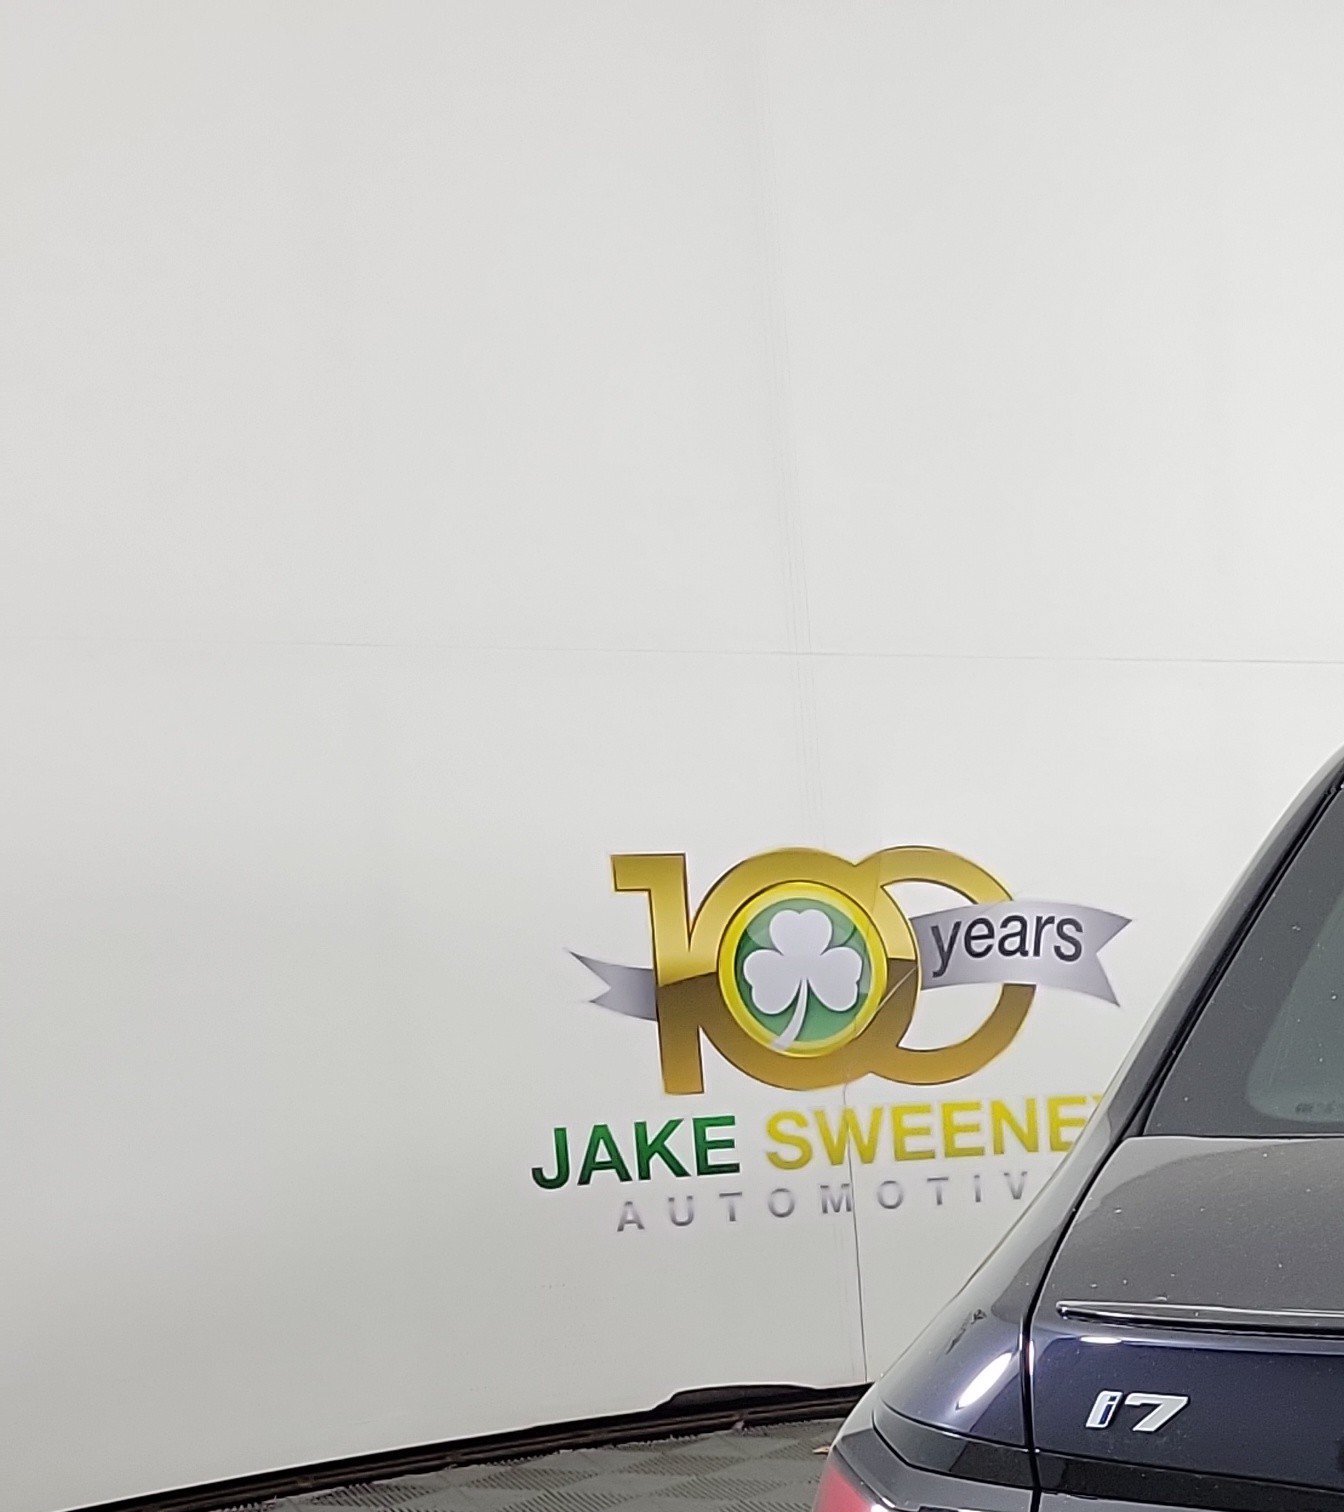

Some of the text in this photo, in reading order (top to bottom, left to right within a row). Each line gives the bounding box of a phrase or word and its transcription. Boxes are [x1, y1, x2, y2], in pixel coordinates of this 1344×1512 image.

[930, 916, 1084, 978] years
[532, 1094, 1103, 1190] JAKE SWEENE
[616, 1170, 1028, 1233] AUTOMOTIV
[1085, 1390, 1189, 1432] i7
